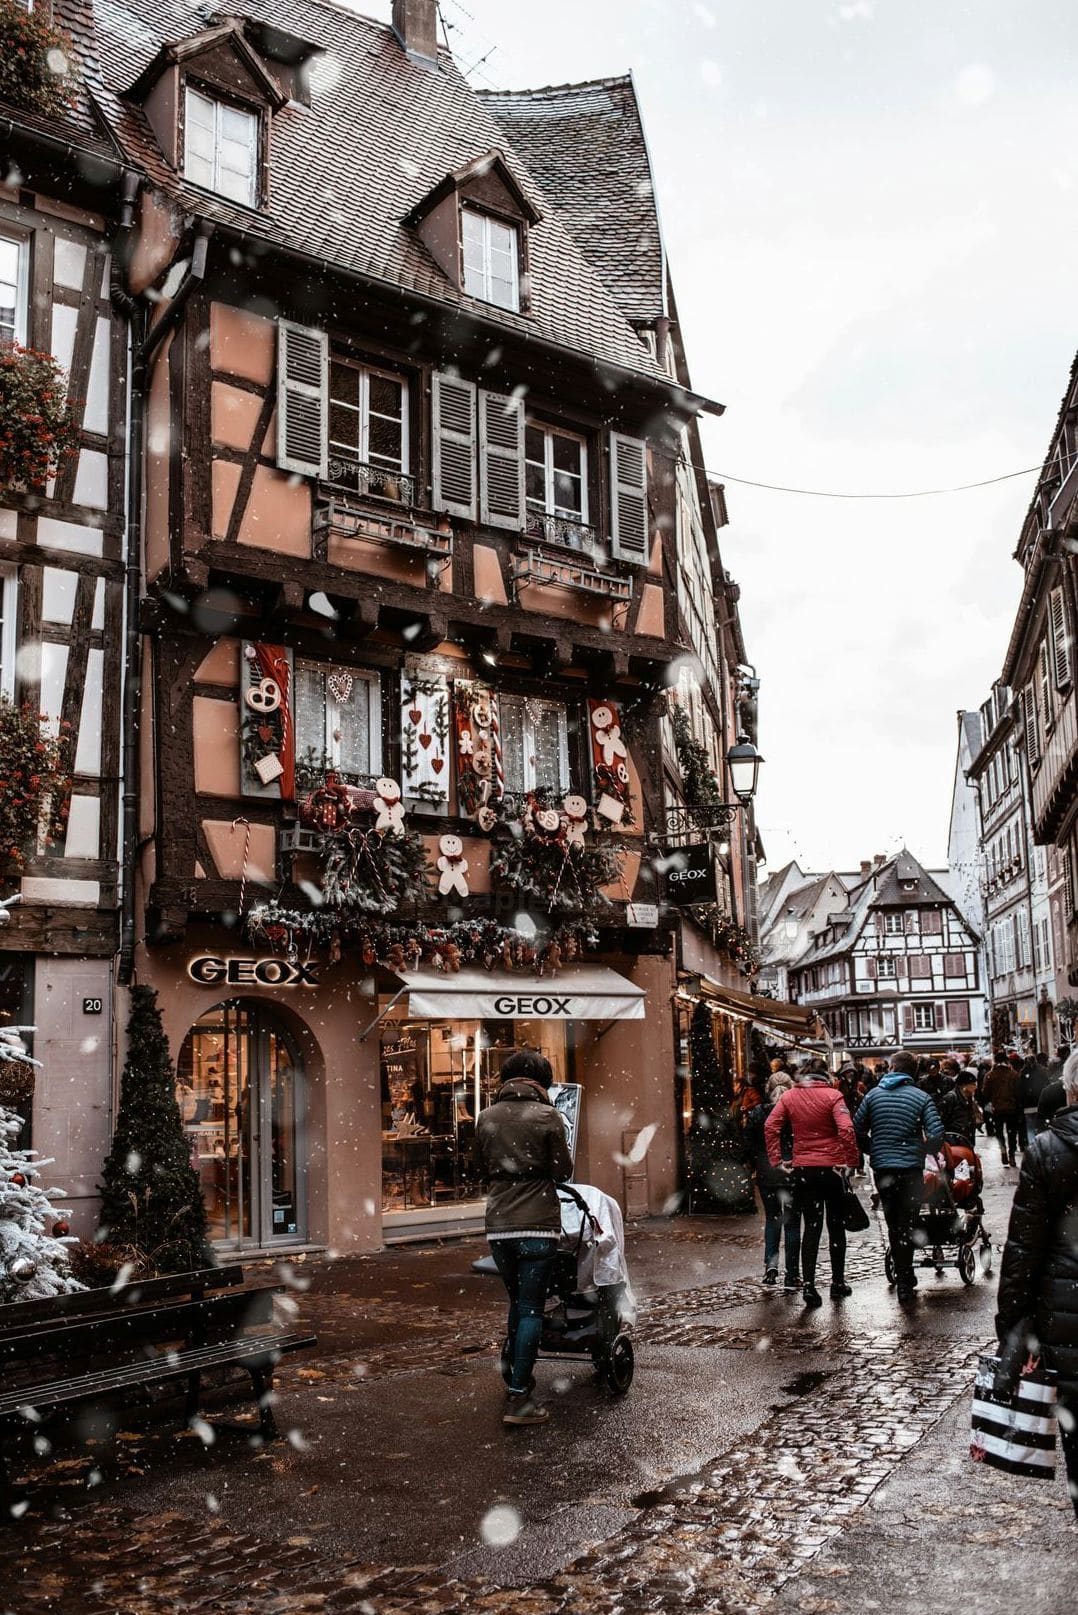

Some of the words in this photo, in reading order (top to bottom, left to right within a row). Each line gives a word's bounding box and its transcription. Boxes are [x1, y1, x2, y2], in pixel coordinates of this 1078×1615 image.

[669, 869, 707, 881] GEOX
[189, 956, 320, 985] GEOX
[86, 999, 101, 1011] 20
[494, 997, 572, 1015] GEOX
